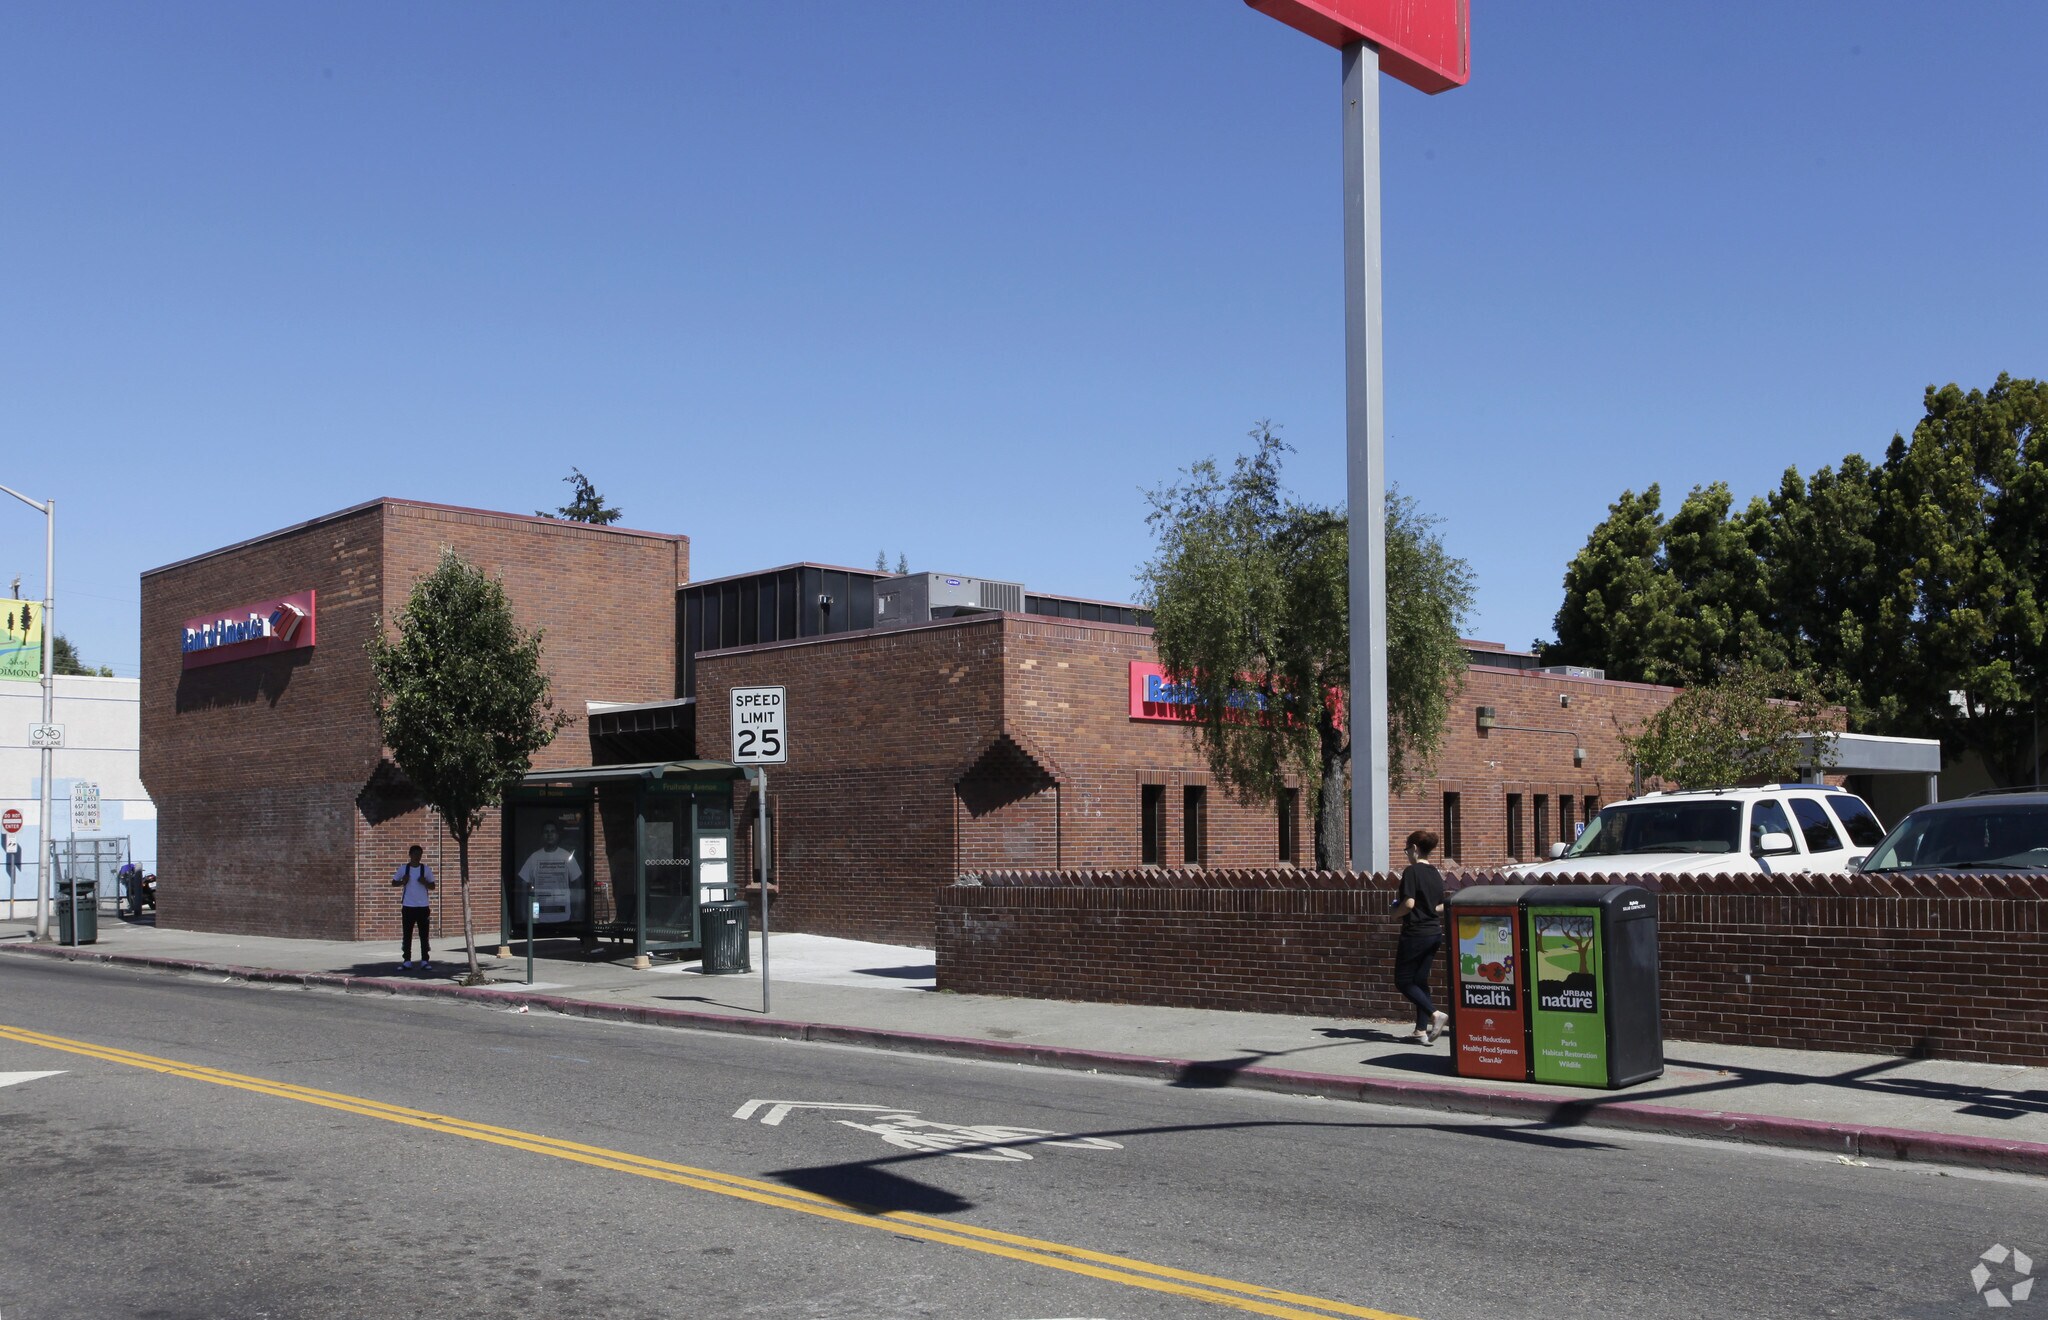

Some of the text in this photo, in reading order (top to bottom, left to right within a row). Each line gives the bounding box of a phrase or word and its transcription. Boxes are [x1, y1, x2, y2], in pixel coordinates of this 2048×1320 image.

[182, 624, 208, 652] Bank
[219, 613, 266, 645] America
[736, 694, 780, 707] SPEED
[741, 711, 775, 724] LIMIT
[738, 729, 781, 757] 25
[1465, 984, 1510, 992] ENVIRONMENTAL
[1563, 989, 1593, 997] URBAN
[1465, 990, 1511, 1006] health
[1542, 994, 1593, 1009] nature
[1469, 1034, 1511, 1044] Toxic Reductions
[1561, 1039, 1577, 1047] Parks
[1462, 1045, 1482, 1053] Healthy
[1496, 1046, 1519, 1055] Systems
[1542, 1049, 1598, 1059] Habitat Restoration
[1478, 1055, 1503, 1064] Clean Air
[1558, 1060, 1581, 1069] Wildlife
